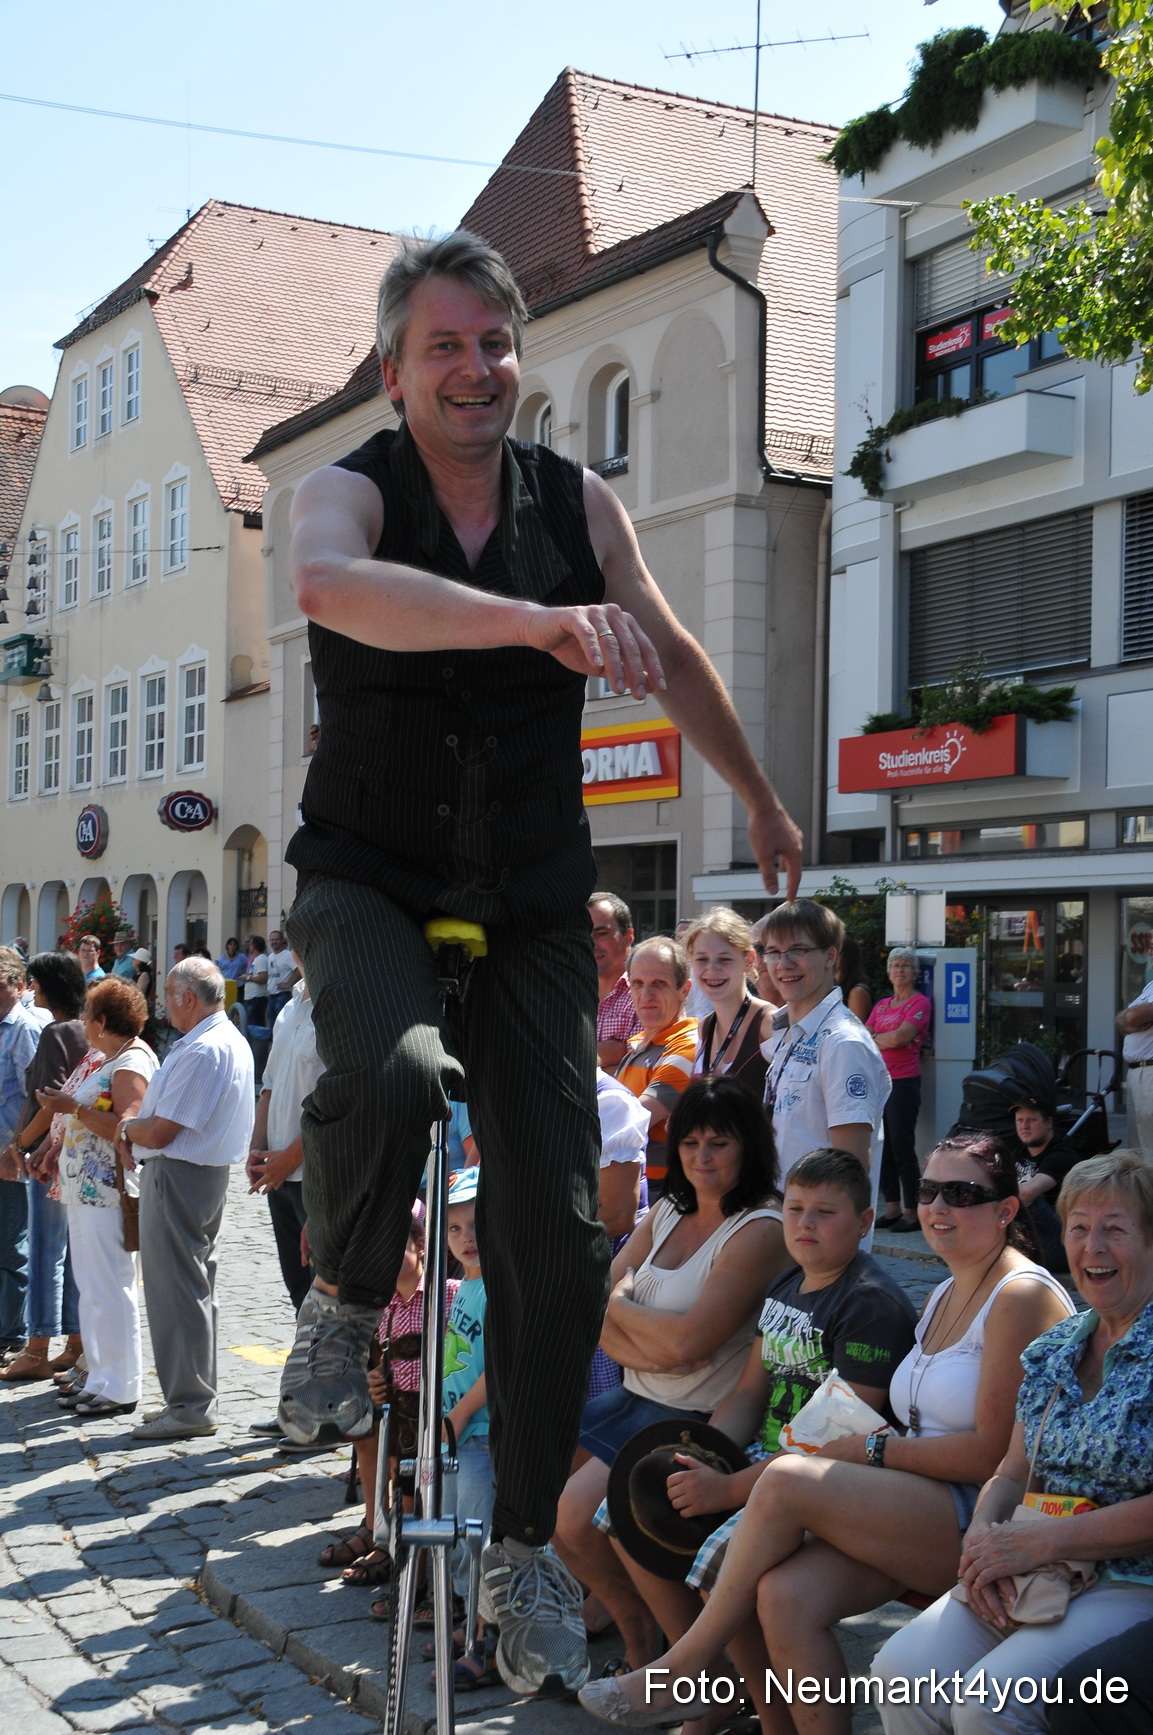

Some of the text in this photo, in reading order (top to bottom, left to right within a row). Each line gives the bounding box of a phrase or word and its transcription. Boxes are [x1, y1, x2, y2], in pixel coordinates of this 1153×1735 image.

[928, 334, 963, 354] Studienkreis
[879, 745, 951, 770] Studienkreis
[175, 801, 205, 820] C&A
[78, 820, 95, 843] C&A
[952, 971, 966, 998] P
[1040, 1501, 1063, 1516] now
